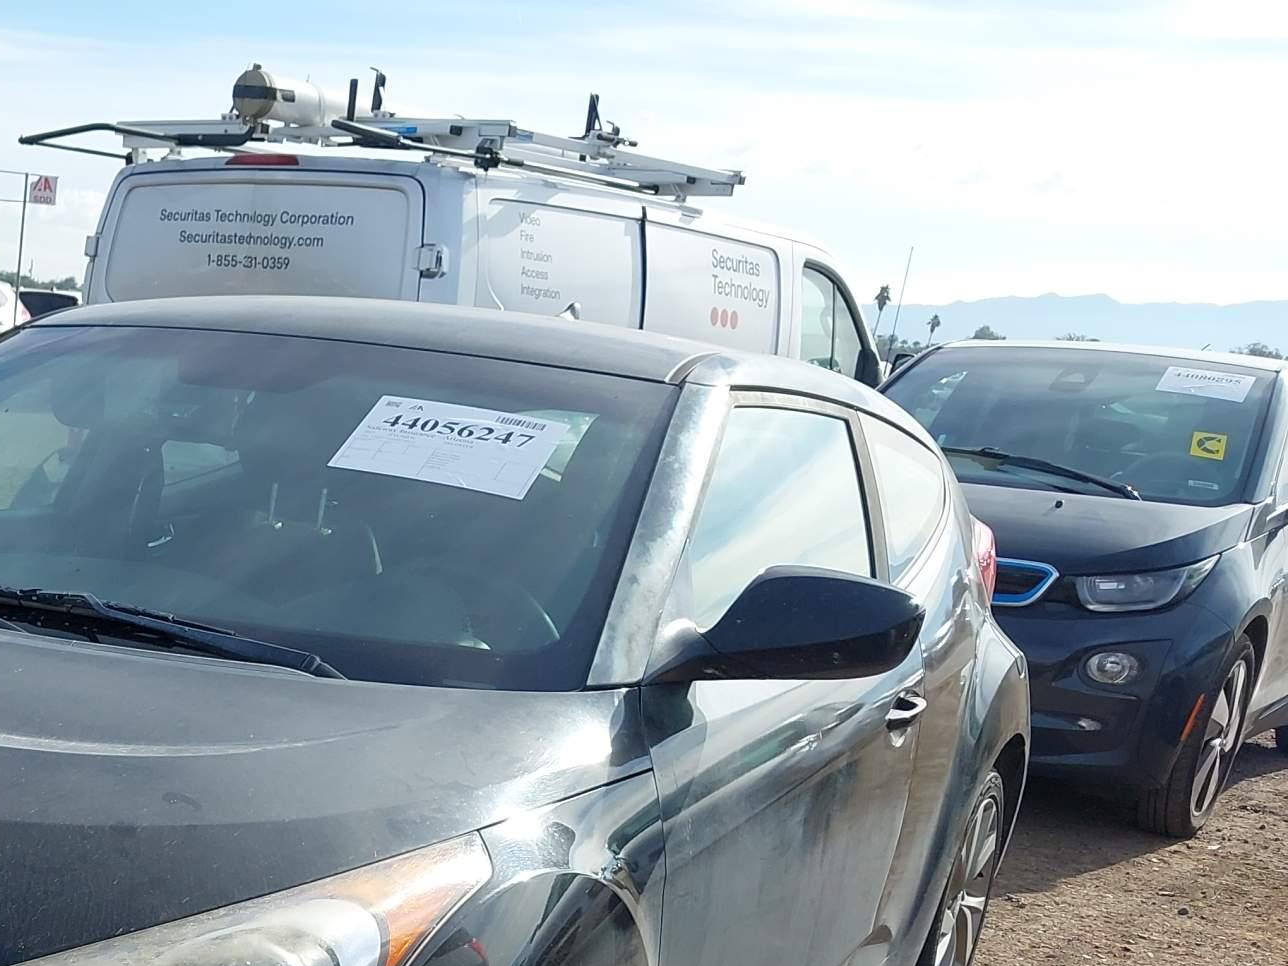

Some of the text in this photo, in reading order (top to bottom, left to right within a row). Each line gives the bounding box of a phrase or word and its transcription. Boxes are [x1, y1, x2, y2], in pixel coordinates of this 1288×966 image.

[159, 208, 211, 223] Securitas
[279, 210, 355, 227] Corporation
[518, 211, 541, 227] Video
[519, 229, 535, 243] Fire
[520, 248, 553, 264] Intrusion
[711, 248, 761, 277] Securitas
[520, 266, 549, 281] Access
[520, 283, 561, 300] Integration
[711, 273, 770, 309] Technology
[383, 414, 536, 448] 44056247
